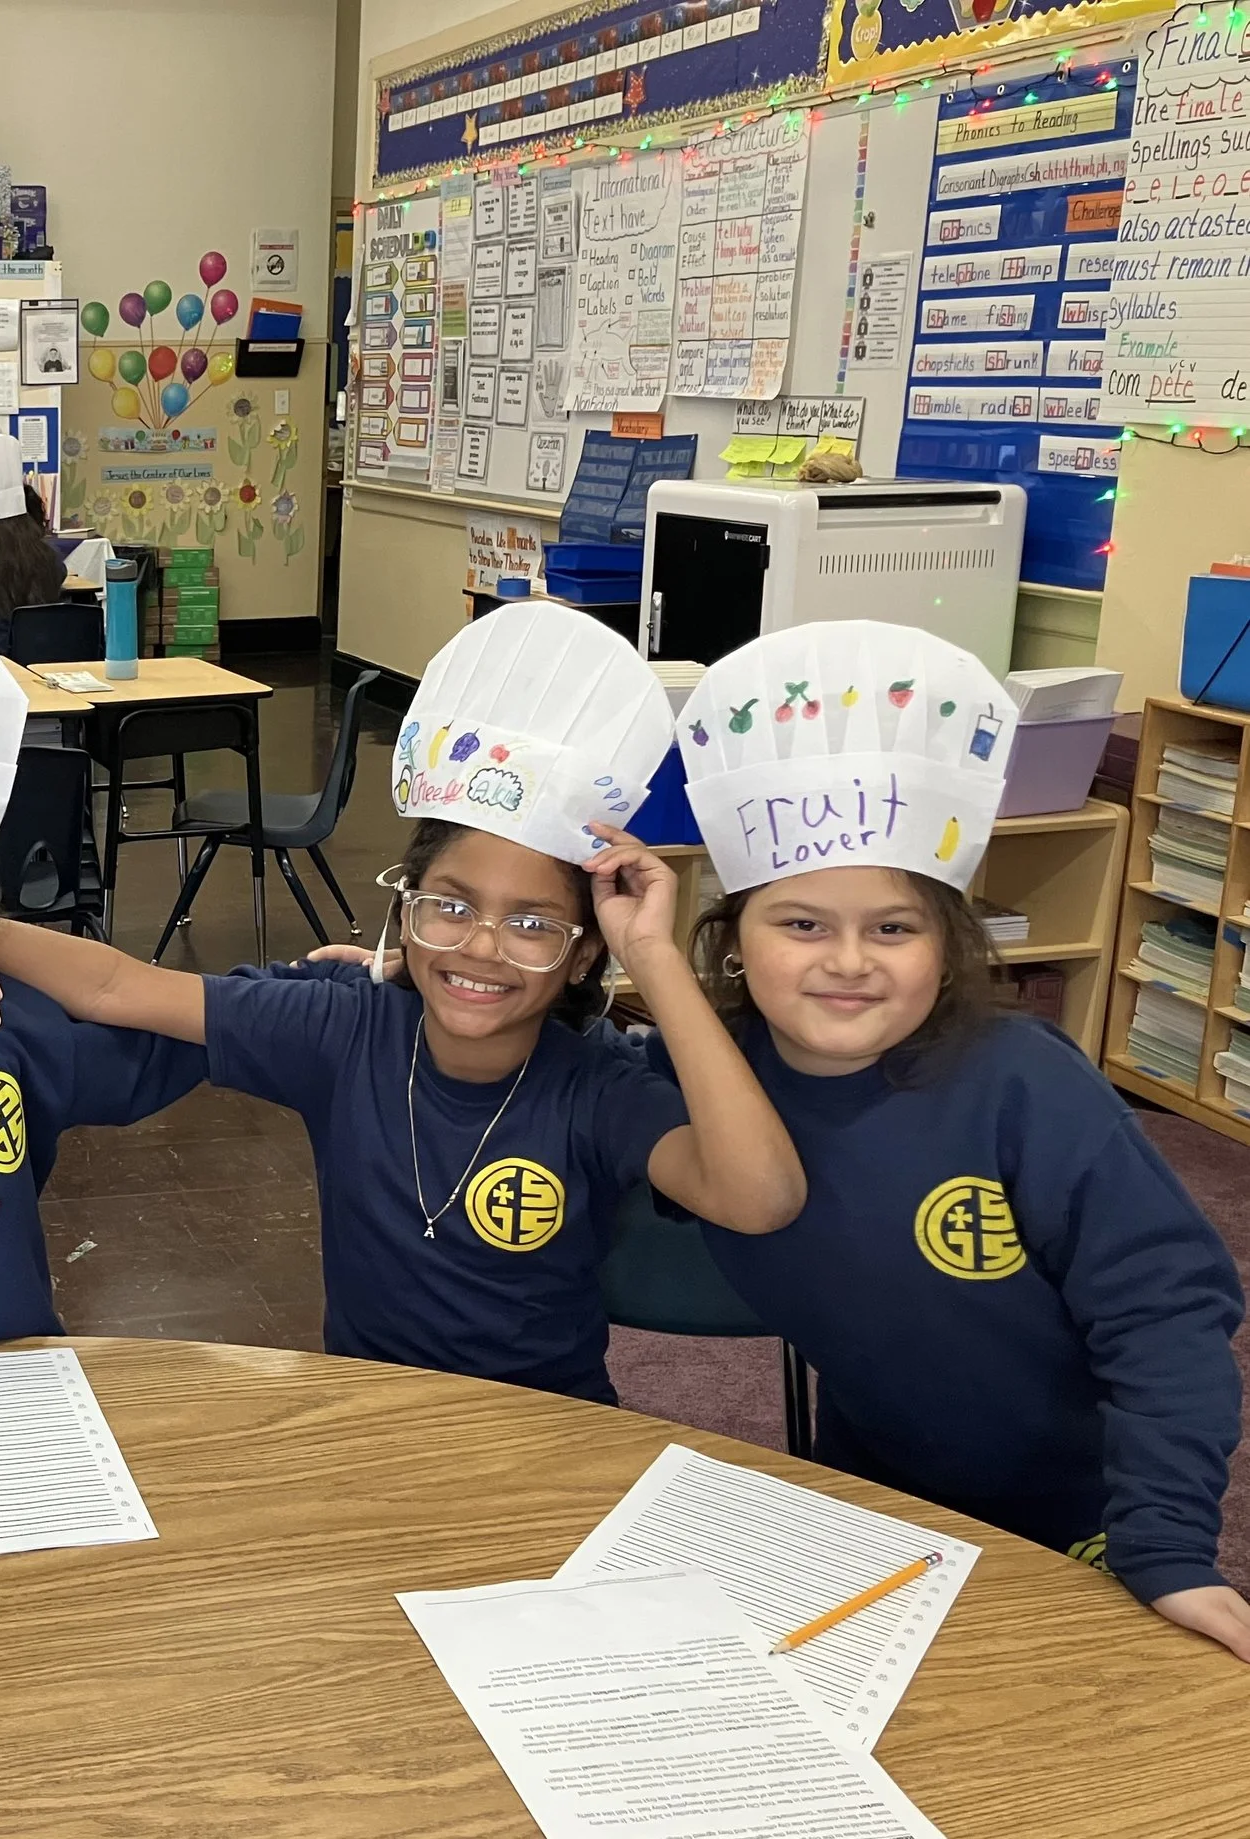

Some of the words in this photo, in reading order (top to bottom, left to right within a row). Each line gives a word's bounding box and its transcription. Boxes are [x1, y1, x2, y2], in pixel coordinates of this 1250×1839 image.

[855, 20, 878, 44] Crop!
[1135, 97, 1170, 125] The
[1176, 84, 1226, 120] final
[955, 121, 1001, 143] Phonics
[1011, 115, 1025, 134] to
[1033, 107, 1079, 133] Reading
[721, 119, 799, 156] Structures
[593, 159, 665, 202] Informational
[772, 174, 790, 186] next
[584, 205, 614, 236] Text
[620, 203, 645, 229] have
[686, 205, 708, 218] Order
[1072, 200, 1121, 227] Challenge
[718, 220, 736, 239] tell
[943, 221, 992, 243] phonics
[1120, 213, 1160, 242] also
[1165, 208, 1199, 239] act
[1199, 213, 1223, 238] as
[370, 232, 415, 260] SCHEDUL
[682, 231, 707, 244] Cause
[763, 234, 785, 244] when
[590, 248, 619, 272] Heading
[681, 251, 707, 268] Effect
[716, 242, 738, 267] things
[1, 263, 16, 275] the
[18, 263, 44, 275] month
[931, 262, 991, 286] telephone
[1006, 257, 1053, 281] thump
[1112, 251, 1161, 281] must
[1166, 255, 1231, 280] remain
[587, 271, 619, 298] Caption
[637, 267, 658, 287] Bold
[757, 271, 794, 289] problem
[641, 284, 665, 304] Words
[681, 279, 711, 298] Problem
[760, 285, 791, 302] solution
[587, 297, 617, 316] Labels
[684, 298, 698, 315] and
[755, 303, 789, 320] resolution
[1108, 292, 1178, 329] Syllables
[678, 316, 705, 333] Solution
[928, 308, 968, 328] shame
[986, 304, 1028, 331] fishing
[677, 341, 704, 359] Compare
[1118, 330, 1179, 366] Example
[916, 352, 975, 376] chopsticks
[987, 351, 1038, 371] shrunk
[1108, 369, 1141, 396] com
[1148, 368, 1195, 408] pete
[736, 400, 756, 416] What
[781, 401, 800, 417] What
[823, 402, 842, 419] What
[915, 395, 962, 415] thimble
[980, 396, 1031, 415] radish
[736, 415, 749, 433] you
[1048, 448, 1118, 472] speechless
[106, 470, 130, 481] Jesus
[130, 469, 142, 479] the
[143, 469, 167, 480] Center
[169, 468, 178, 479] of
[517, 534, 537, 552] marks
[469, 548, 478, 566] to
[737, 772, 908, 858] Fruit
[772, 829, 878, 869] Lover
